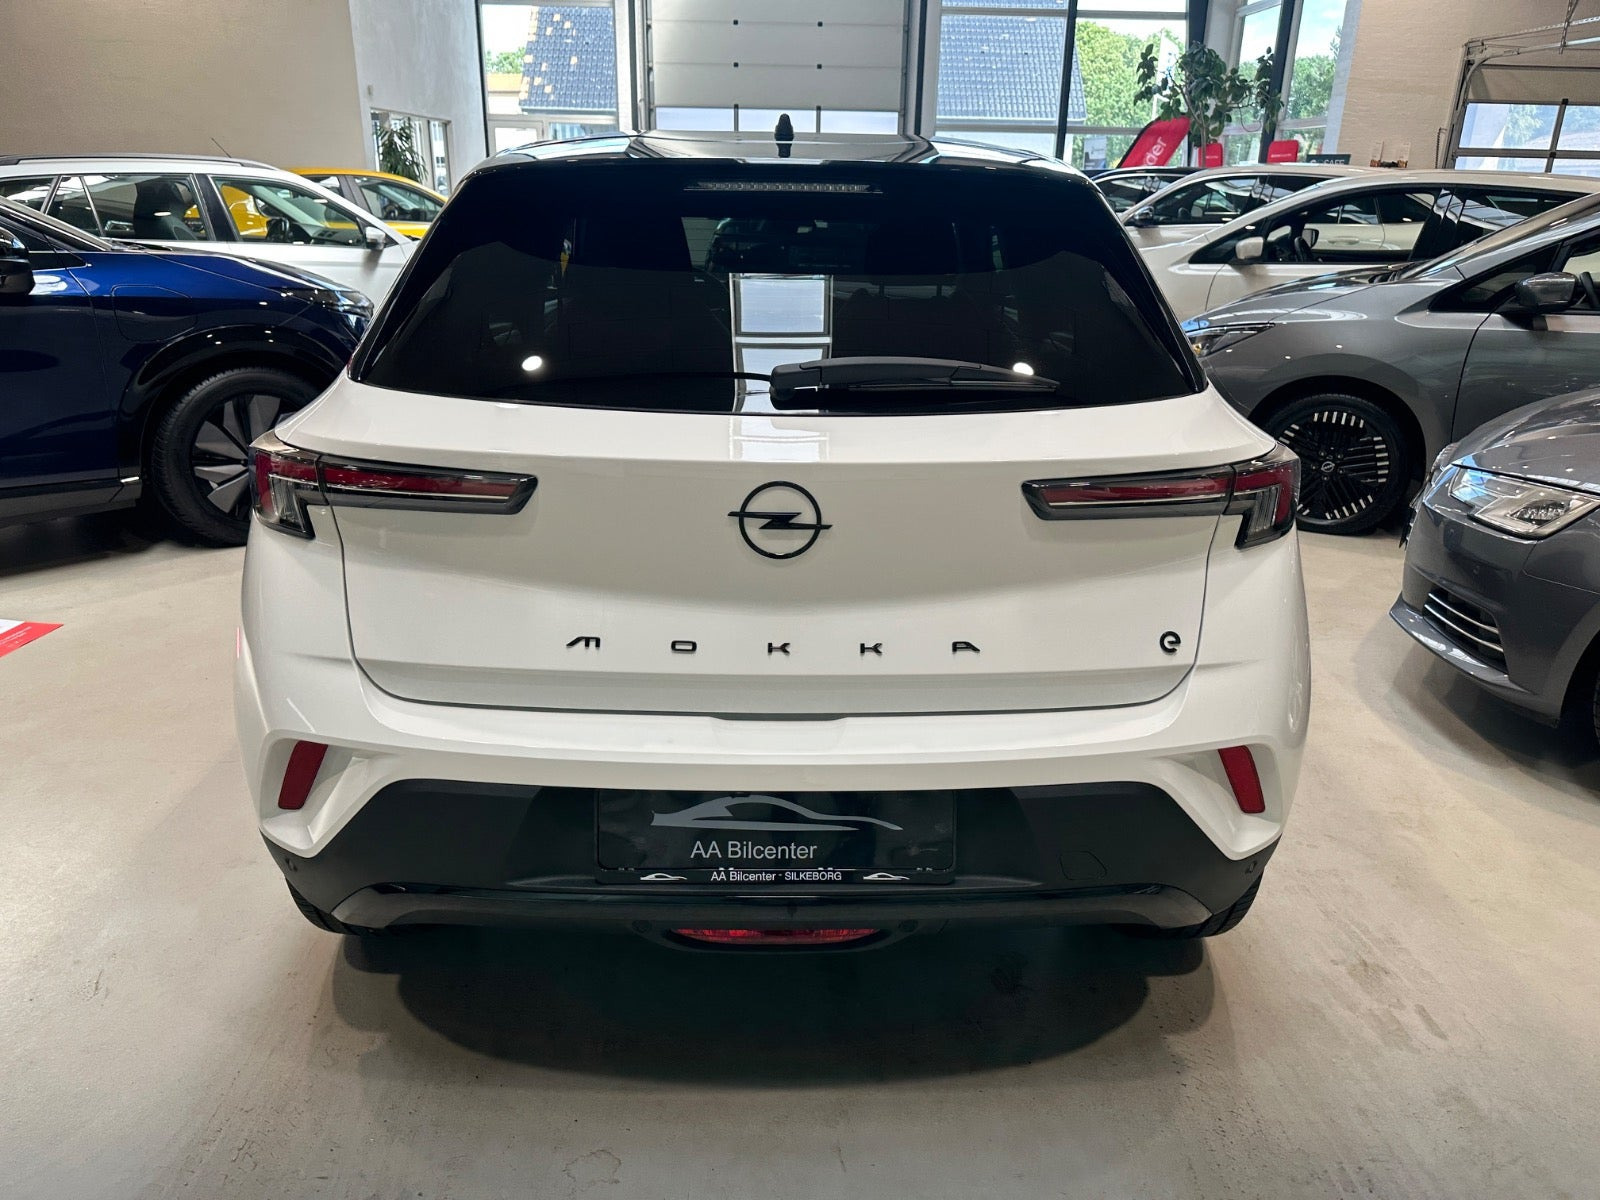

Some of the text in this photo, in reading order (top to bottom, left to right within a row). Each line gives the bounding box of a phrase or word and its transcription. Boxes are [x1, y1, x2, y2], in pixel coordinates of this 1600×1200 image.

[1143, 136, 1167, 167] der
[566, 635, 980, 655] MOKKA
[690, 840, 818, 859] AA Bilcenter
[710, 871, 728, 881] AA
[729, 871, 776, 881] Bilcenter
[784, 871, 842, 881] SILKEBORG
